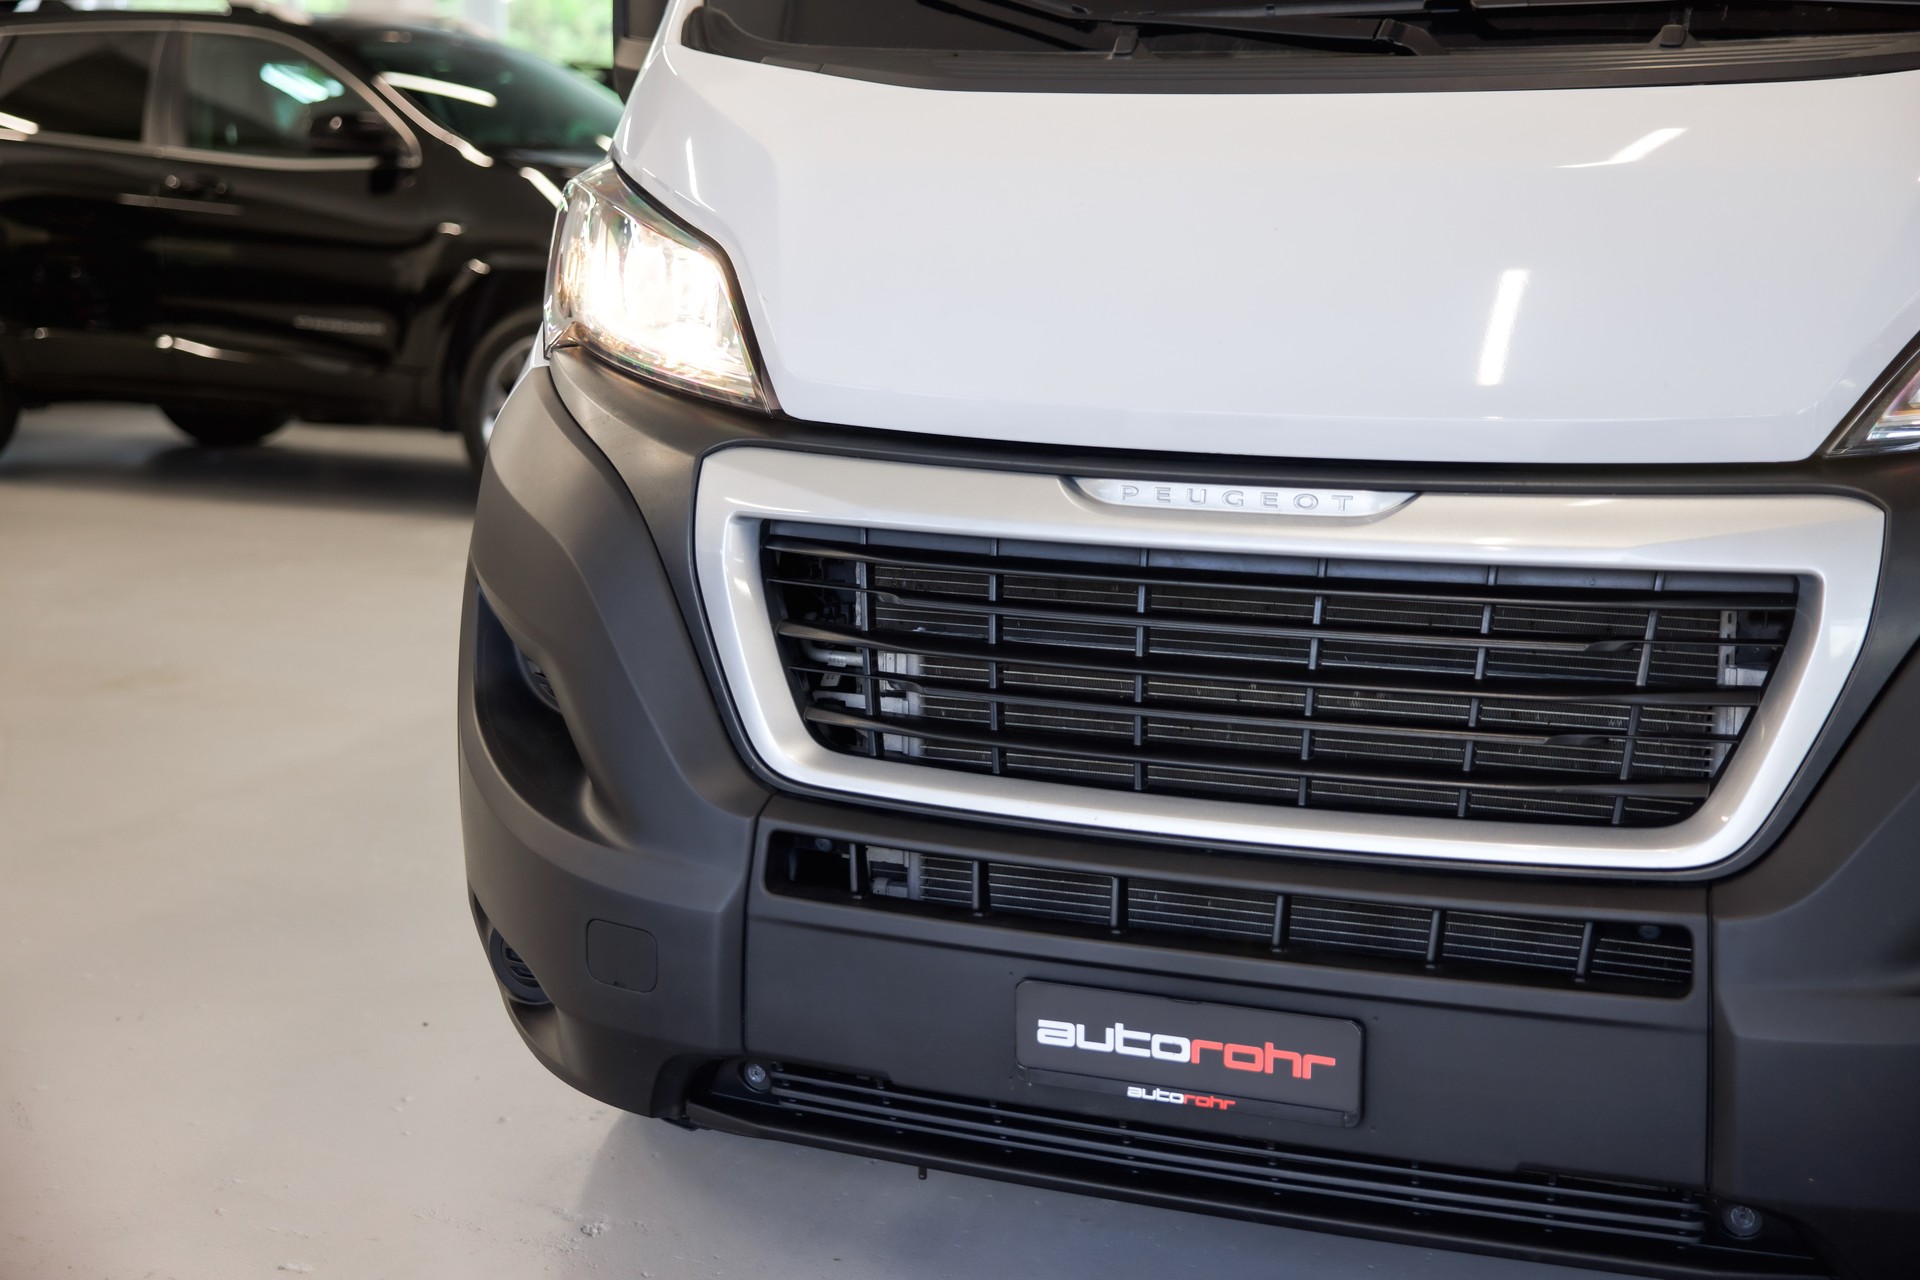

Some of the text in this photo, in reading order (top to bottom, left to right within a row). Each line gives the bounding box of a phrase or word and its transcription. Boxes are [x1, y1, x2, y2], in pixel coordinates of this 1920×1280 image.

[1120, 485, 1354, 511] PEUGEOT
[1037, 1019, 1336, 1080] autorohr
[1127, 1086, 1236, 1110] autorohr
